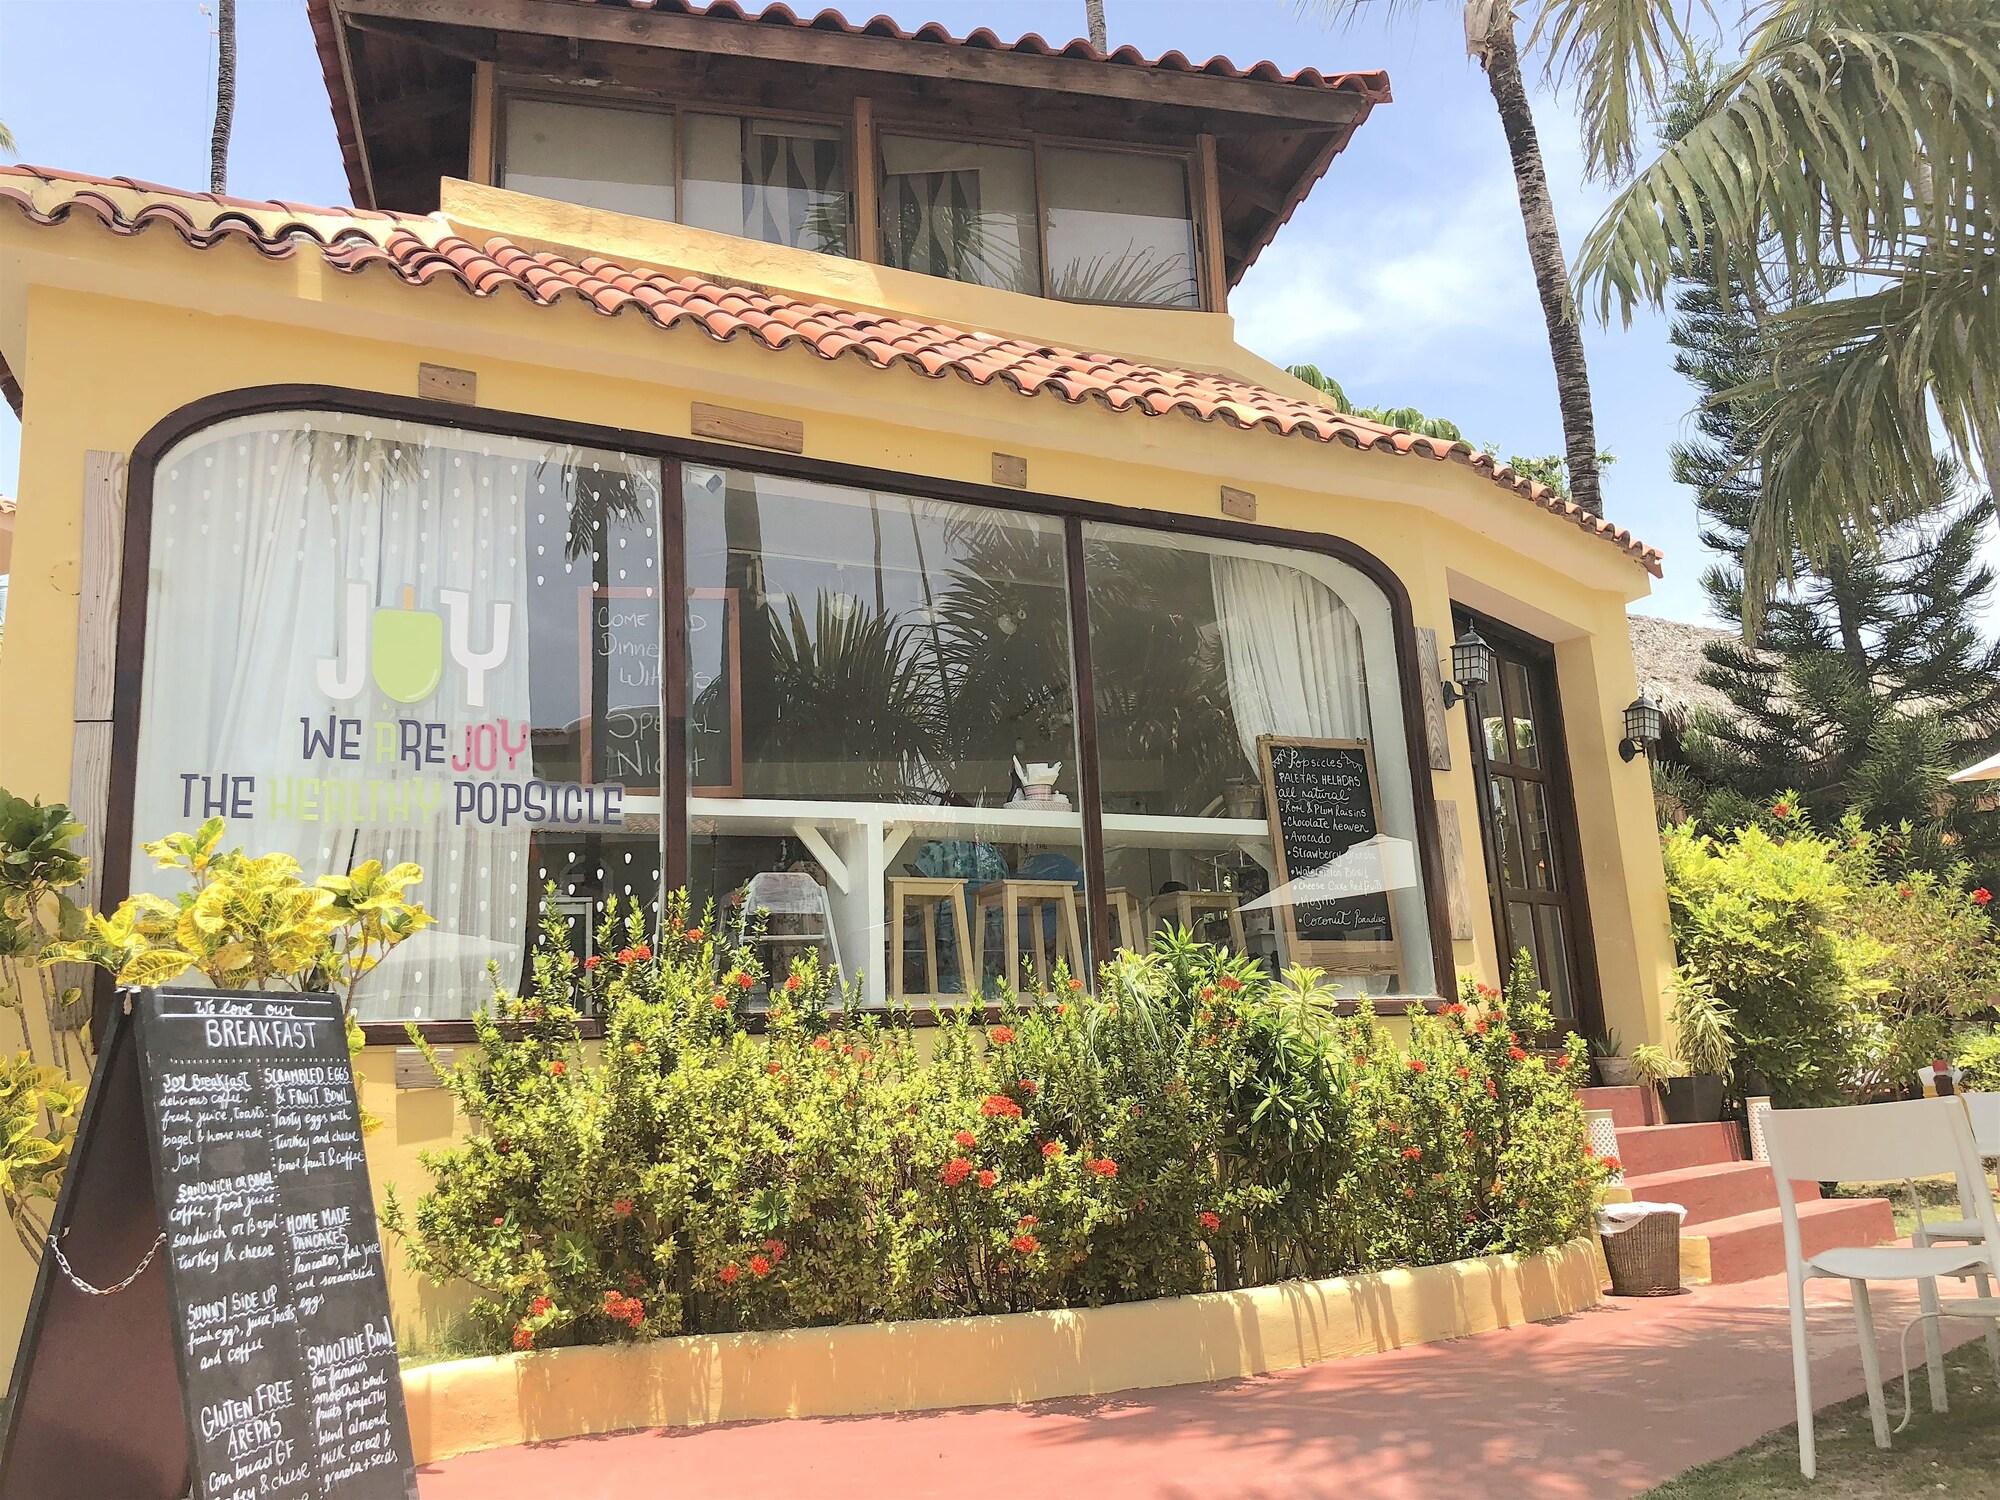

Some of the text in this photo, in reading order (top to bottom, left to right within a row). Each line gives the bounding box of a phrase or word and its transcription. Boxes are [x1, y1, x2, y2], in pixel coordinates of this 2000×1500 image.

[599, 632, 659, 657] Dinne
[300, 715, 529, 772] WE ARE JOY
[1288, 746, 1343, 774] Popsicles
[1278, 772, 1361, 787] PALETAS HELADAS
[180, 772, 623, 826] THE HEALTHY POPSICLE
[1287, 815, 1369, 833] Chocolate heaven
[1290, 830, 1331, 844] Avocado
[1292, 846, 1342, 866] Strawberry
[1303, 910, 1352, 927] Coconut
[194, 999, 296, 1017] We love our
[206, 1019, 317, 1049] BREAKFAST
[264, 1066, 350, 1083] SCRAMBLED EGGS
[160, 1095, 208, 1107] delicious
[275, 1087, 286, 1104] &
[161, 1109, 193, 1131] fresh
[272, 1108, 352, 1130] Tasty eggs with
[162, 1129, 194, 1150] bagel
[206, 1130, 234, 1142] home
[312, 1131, 330, 1144] and
[332, 1130, 360, 1142] cheese
[235, 1174, 247, 1188] OR
[247, 1170, 274, 1187] BAGEL
[214, 1196, 243, 1222] fresh
[243, 1194, 275, 1217] juice
[287, 1206, 351, 1233] HOME MADE
[172, 1224, 227, 1247] sandwich
[292, 1227, 349, 1250] PANCAKES
[239, 1244, 275, 1261] cheese
[296, 1264, 376, 1291] and scrambled
[187, 1296, 227, 1325] SUNNY
[262, 1284, 278, 1303] UP
[299, 1292, 325, 1315] eggs
[200, 1338, 264, 1370] and coffee
[307, 1331, 365, 1371] SMOOTHIE
[328, 1361, 367, 1390] famous
[362, 1368, 388, 1390] bowl
[201, 1379, 294, 1437] GLUTEN FREE
[227, 1412, 282, 1455] AREPAS
[319, 1408, 391, 1446] blend almond
[350, 1433, 381, 1455] cereal
[209, 1438, 295, 1492] Corn bread GF
[260, 1474, 270, 1494] &
[272, 1462, 311, 1489] cheese
